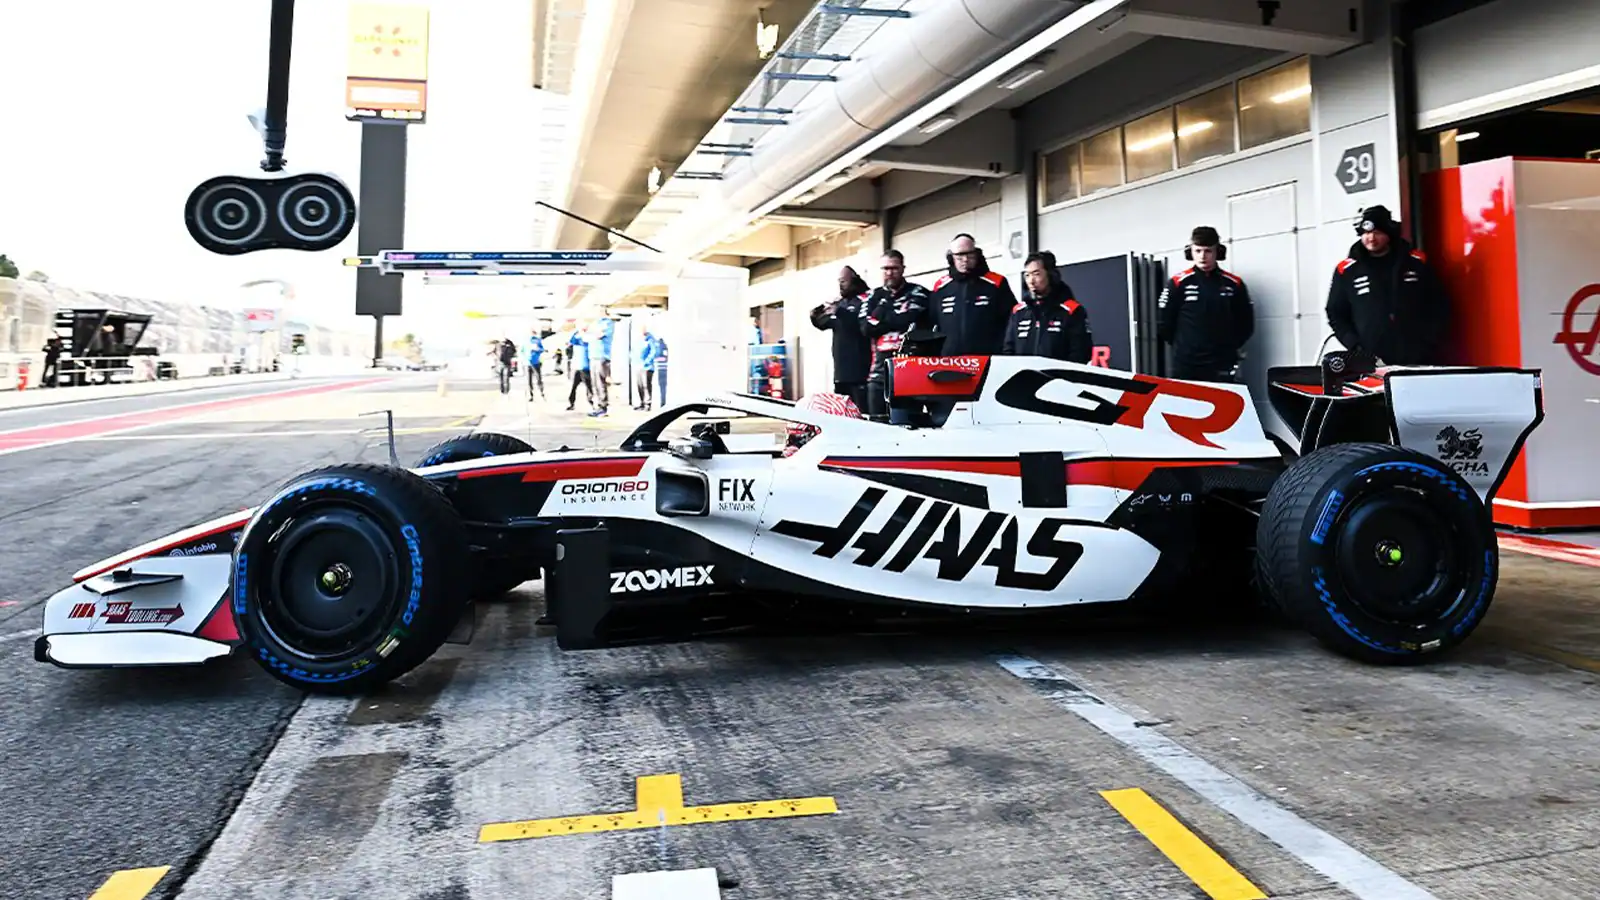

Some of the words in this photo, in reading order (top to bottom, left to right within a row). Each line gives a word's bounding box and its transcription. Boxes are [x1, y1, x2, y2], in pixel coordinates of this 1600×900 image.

[1344, 153, 1373, 186] 39
[917, 356, 980, 368] RUCKUS
[995, 369, 1245, 450] GR
[561, 481, 649, 495] ORION180
[563, 494, 647, 504] INSURANCE
[719, 479, 755, 501] FIX
[718, 502, 756, 512] NETWORK
[184, 542, 217, 556] infobip
[770, 486, 1121, 591] HAAS
[401, 524, 423, 626] Cinturato
[610, 565, 715, 593] ZOOMEX
